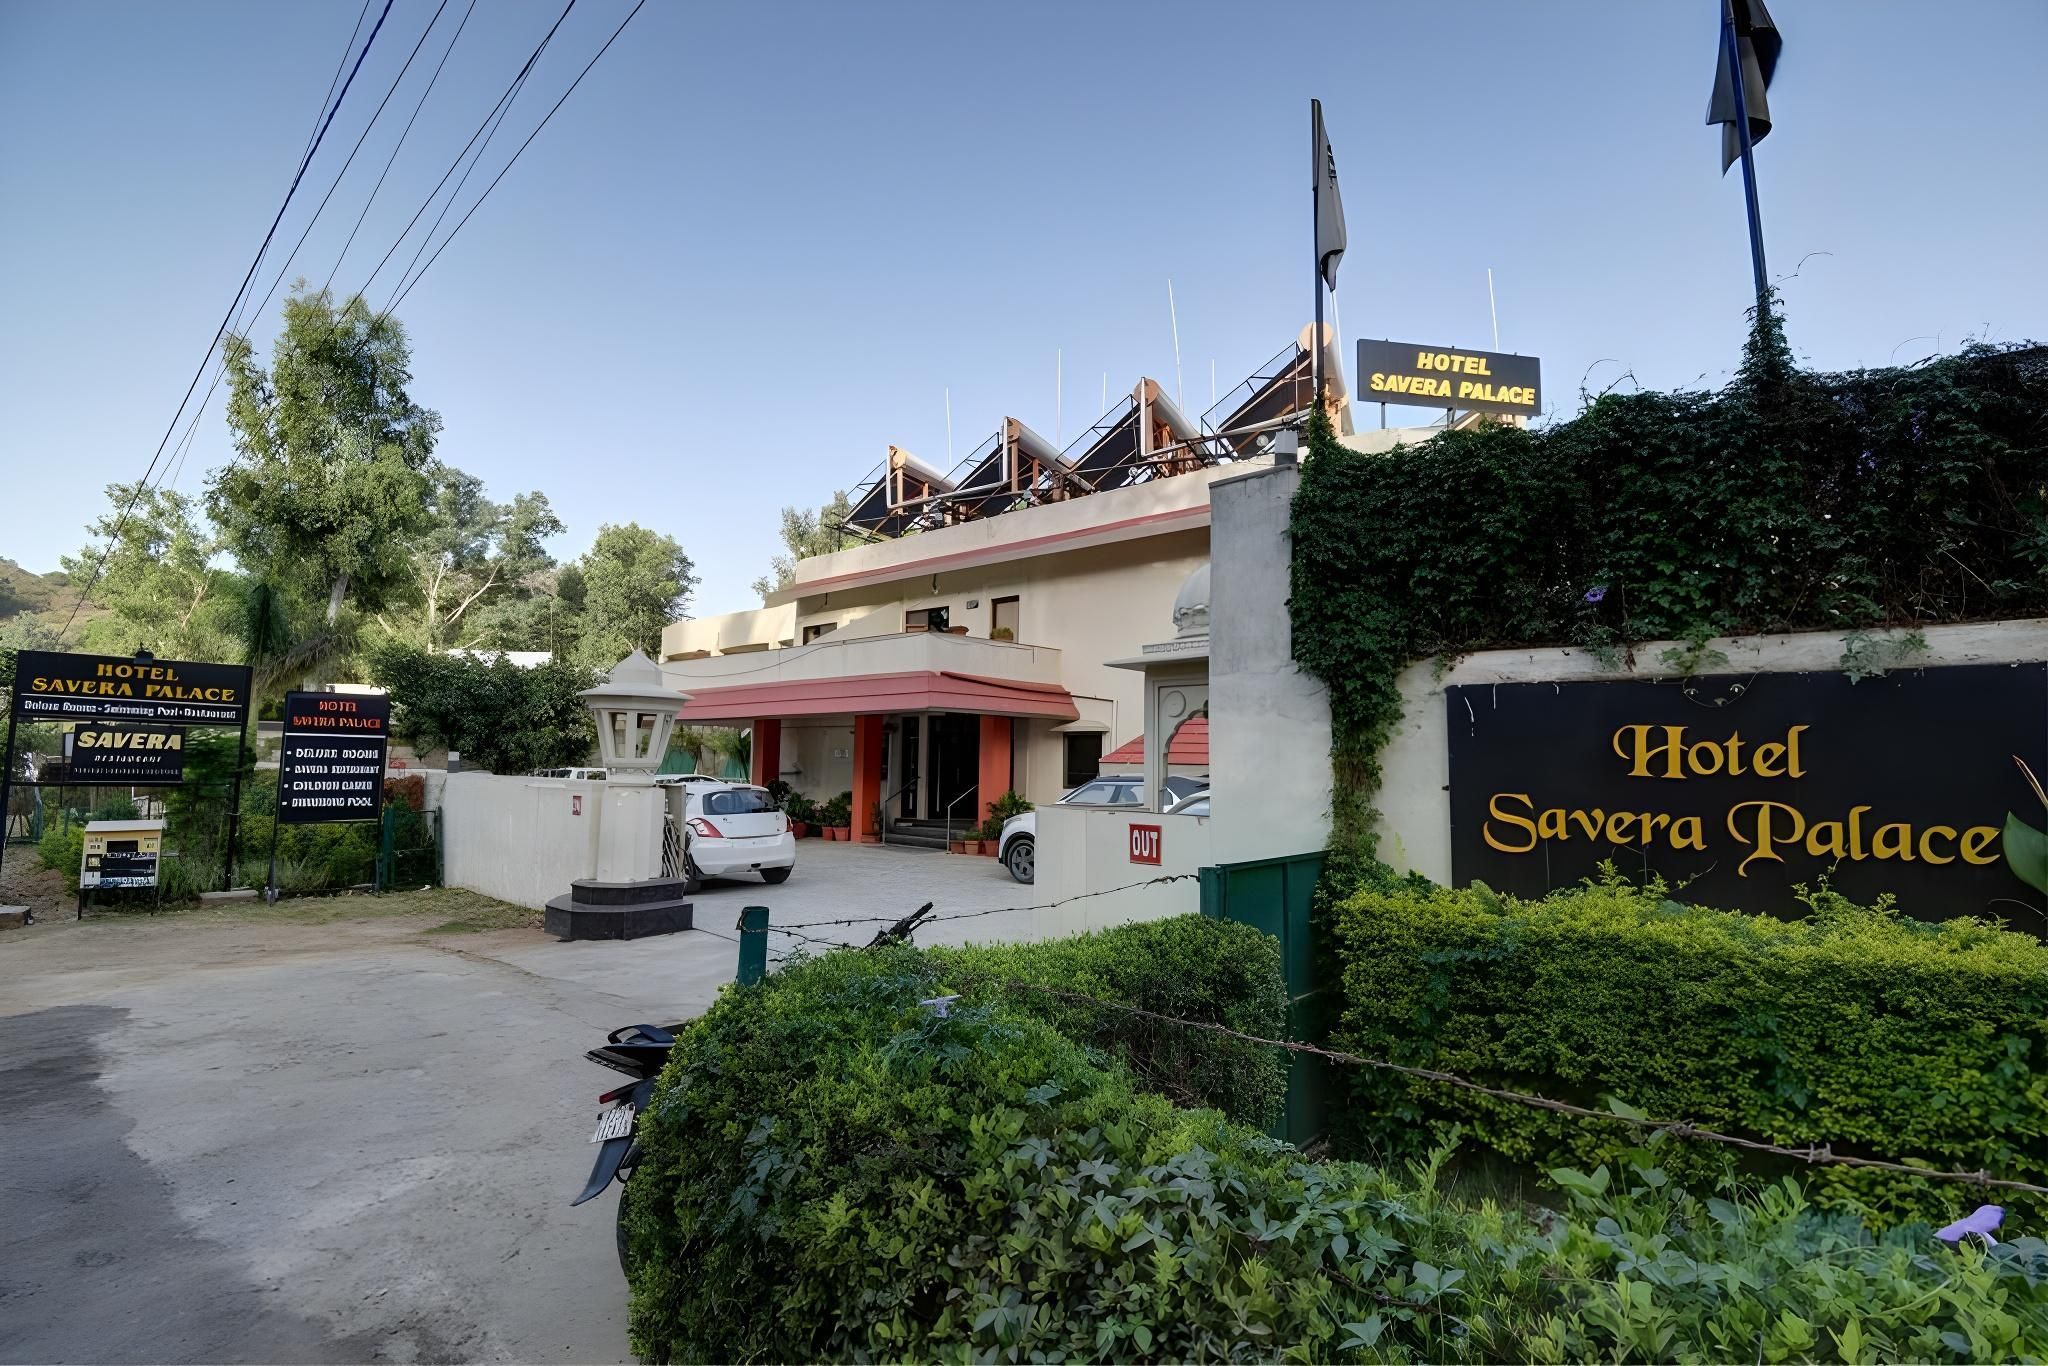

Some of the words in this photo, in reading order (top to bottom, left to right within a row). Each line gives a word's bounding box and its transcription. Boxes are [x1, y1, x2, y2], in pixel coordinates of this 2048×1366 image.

[1416, 352, 1492, 376] HOTEL
[1370, 373, 1452, 397] SAVERA
[1458, 381, 1536, 405] PALACE
[96, 663, 179, 682] HOTEL
[31, 677, 133, 697] SAVERA
[145, 684, 234, 701] PALACE
[77, 731, 182, 750] SAVERA
[1611, 723, 1810, 779] Hotel
[1132, 829, 1159, 859] OUT
[1482, 793, 1708, 854] Savera
[1726, 800, 2001, 878] Palace
